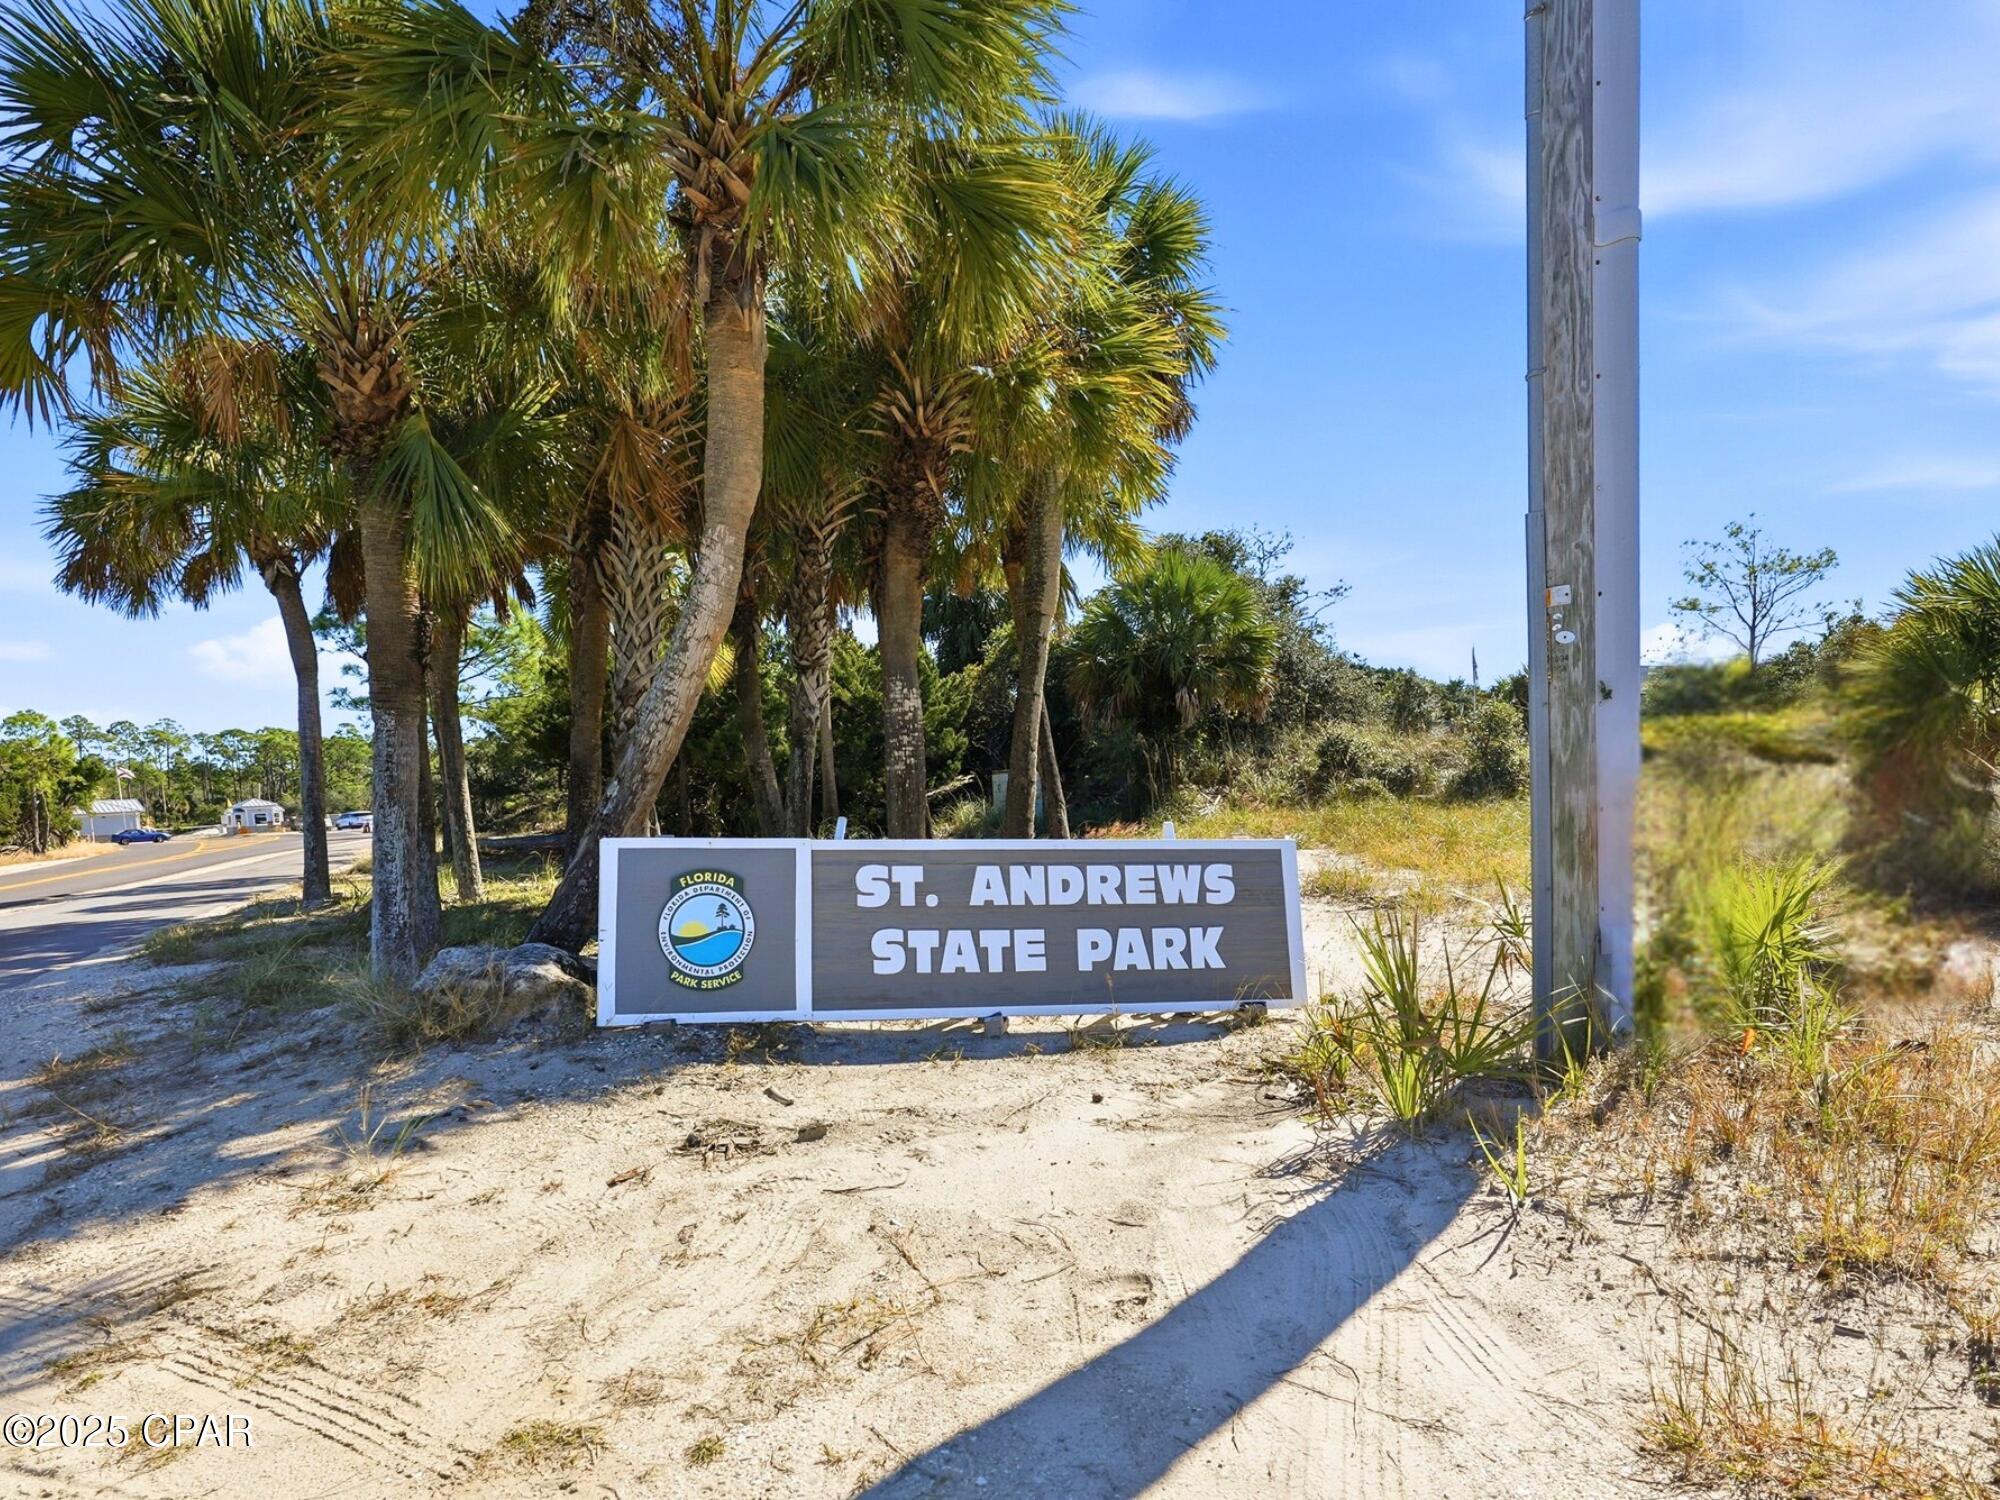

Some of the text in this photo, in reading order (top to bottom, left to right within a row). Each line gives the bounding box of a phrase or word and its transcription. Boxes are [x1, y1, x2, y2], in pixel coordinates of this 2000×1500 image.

[679, 872, 735, 888] FLORIDA
[693, 885, 745, 908] DEPARTMENT
[856, 863, 1236, 908] ST. ANDREWS
[660, 930, 753, 975] ENVIRONMENTAL PROTECTION
[871, 926, 1227, 975] STATE PARK
[670, 970, 742, 989] PARK SERVICE
